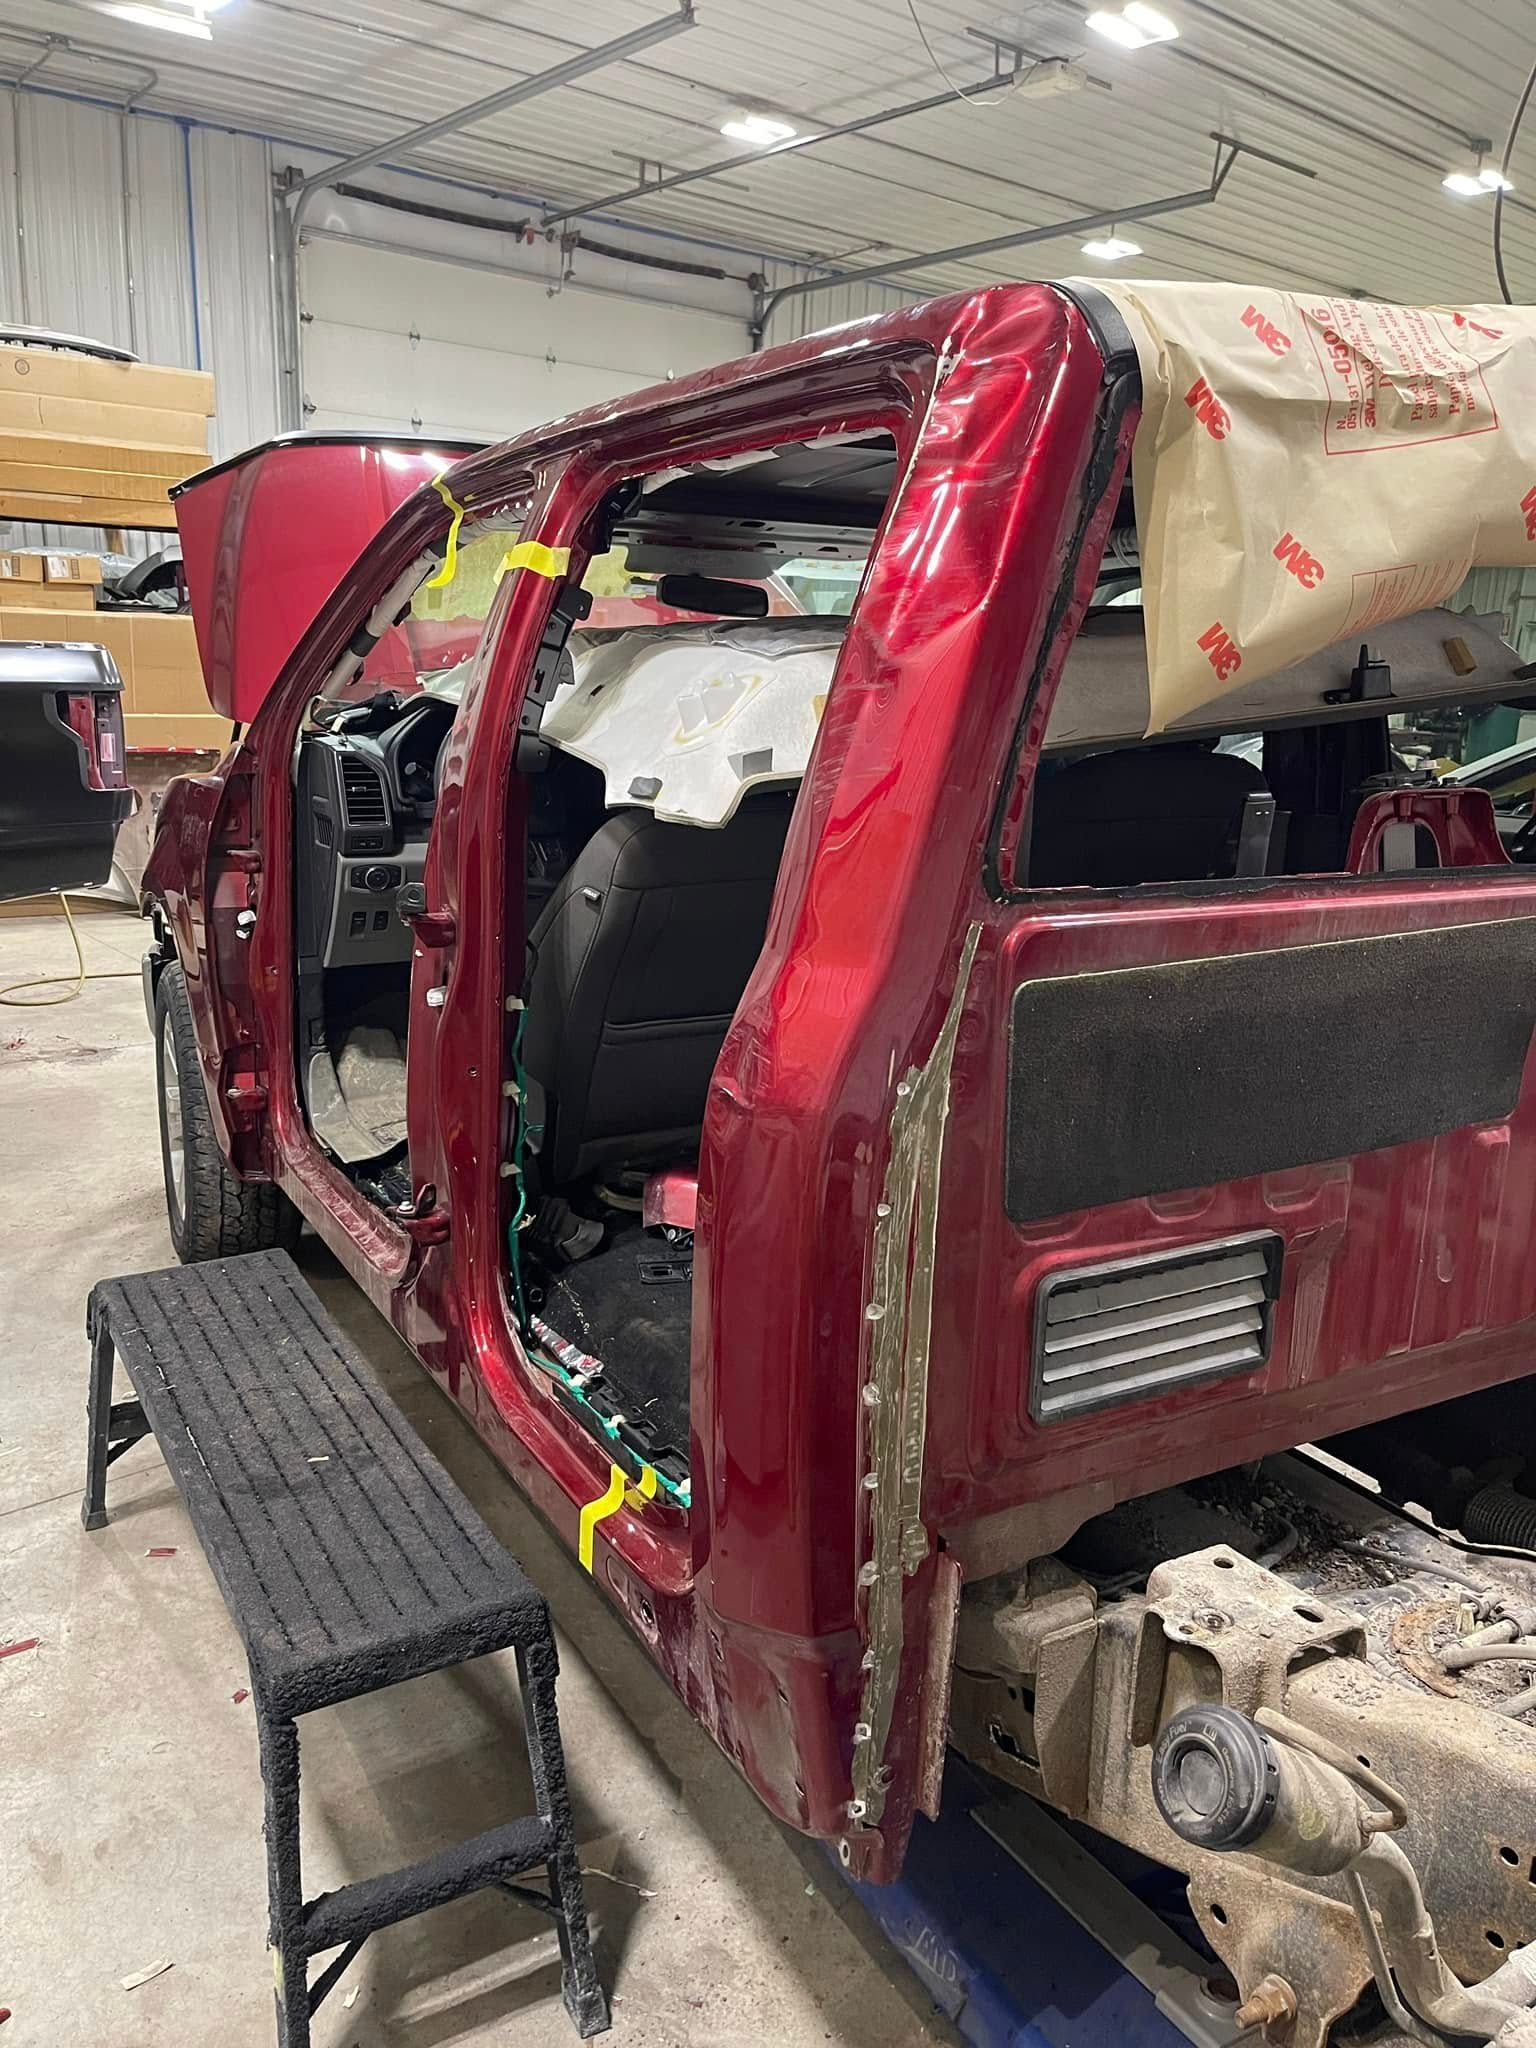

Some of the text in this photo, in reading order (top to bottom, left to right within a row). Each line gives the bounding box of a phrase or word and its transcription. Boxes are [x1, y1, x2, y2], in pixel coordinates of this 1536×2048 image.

[1240, 304, 1292, 356] 3M
[1184, 376, 1231, 441] 3M
[1365, 398, 1376, 428] 3M
[1407, 383, 1425, 422] Papel
[1272, 532, 1324, 589] 3M
[1196, 622, 1242, 681] 3M
